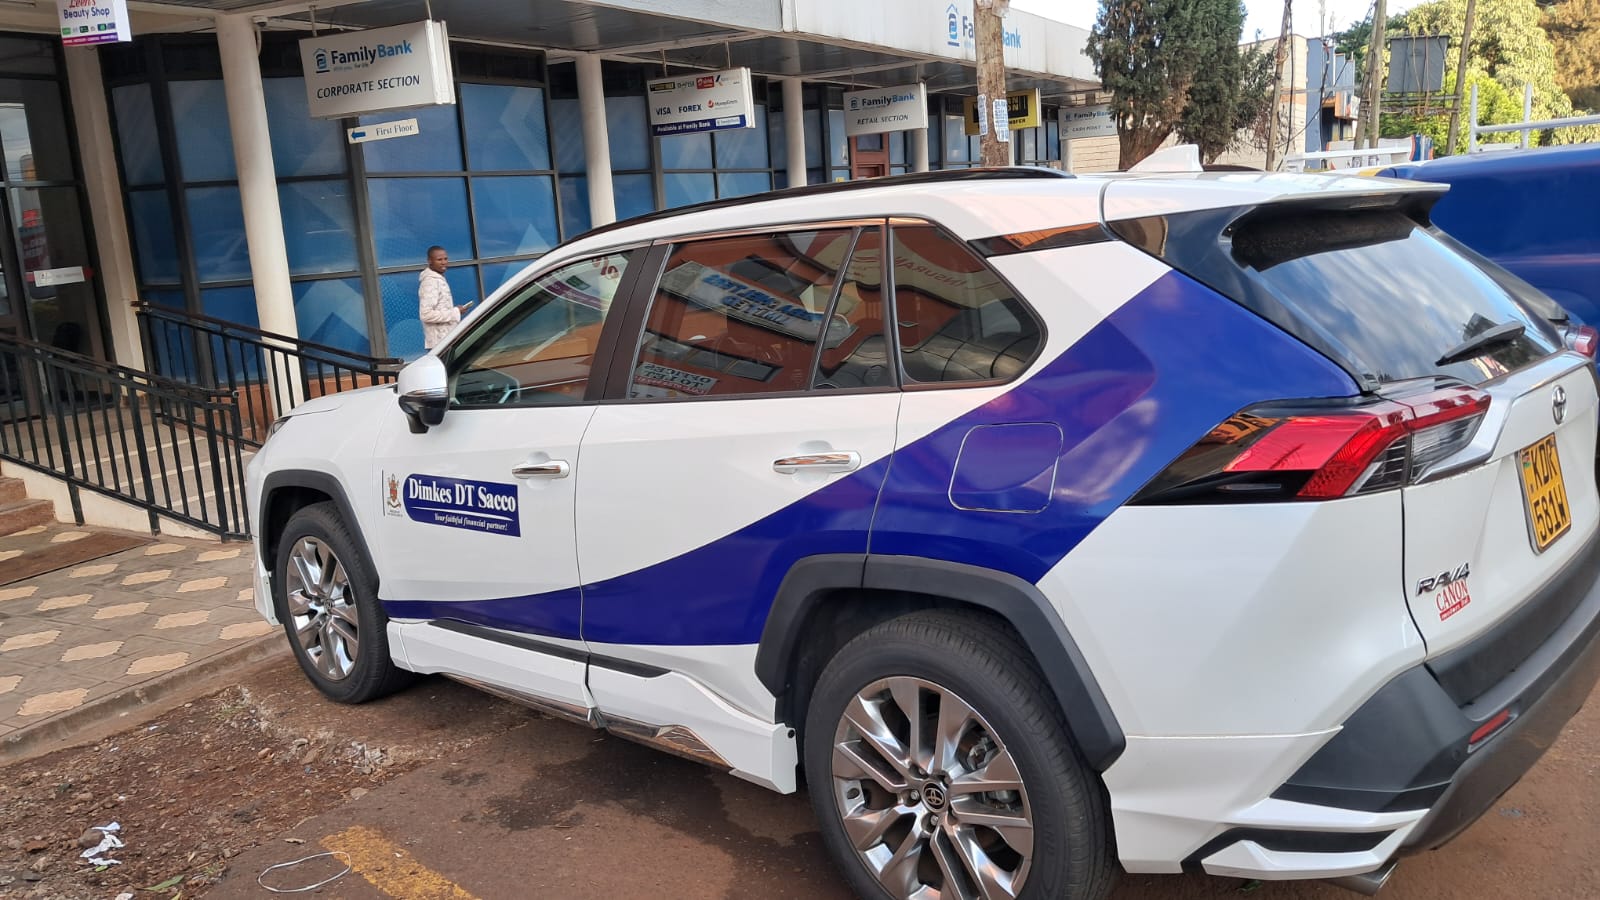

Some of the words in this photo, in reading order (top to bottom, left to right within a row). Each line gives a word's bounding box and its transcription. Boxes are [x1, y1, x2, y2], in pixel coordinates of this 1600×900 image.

[63, 9, 90, 19] Beauty
[91, 7, 110, 17] Shop
[331, 40, 413, 64] FamilyBank
[317, 81, 374, 99] CORPORATE
[378, 75, 420, 90] SECTION
[862, 93, 916, 106] FamilyBank
[656, 107, 671, 116] VISA
[678, 104, 702, 113] FOREX
[1074, 110, 1111, 119] FamilyBan
[683, 122, 698, 130] Family
[699, 121, 711, 129] Bank
[881, 114, 909, 123] SECTION
[376, 127, 392, 136] First
[394, 124, 414, 134] Floor
[1530, 439, 1557, 490] KDR
[408, 478, 452, 504] Dimkes
[454, 484, 475, 507] DT
[478, 486, 516, 512] Sacco
[1533, 484, 1567, 541] 581W
[434, 513, 445, 521] Your
[463, 518, 486, 528] financial
[486, 521, 508, 531] partner!
[1436, 577, 1469, 611] CANON
